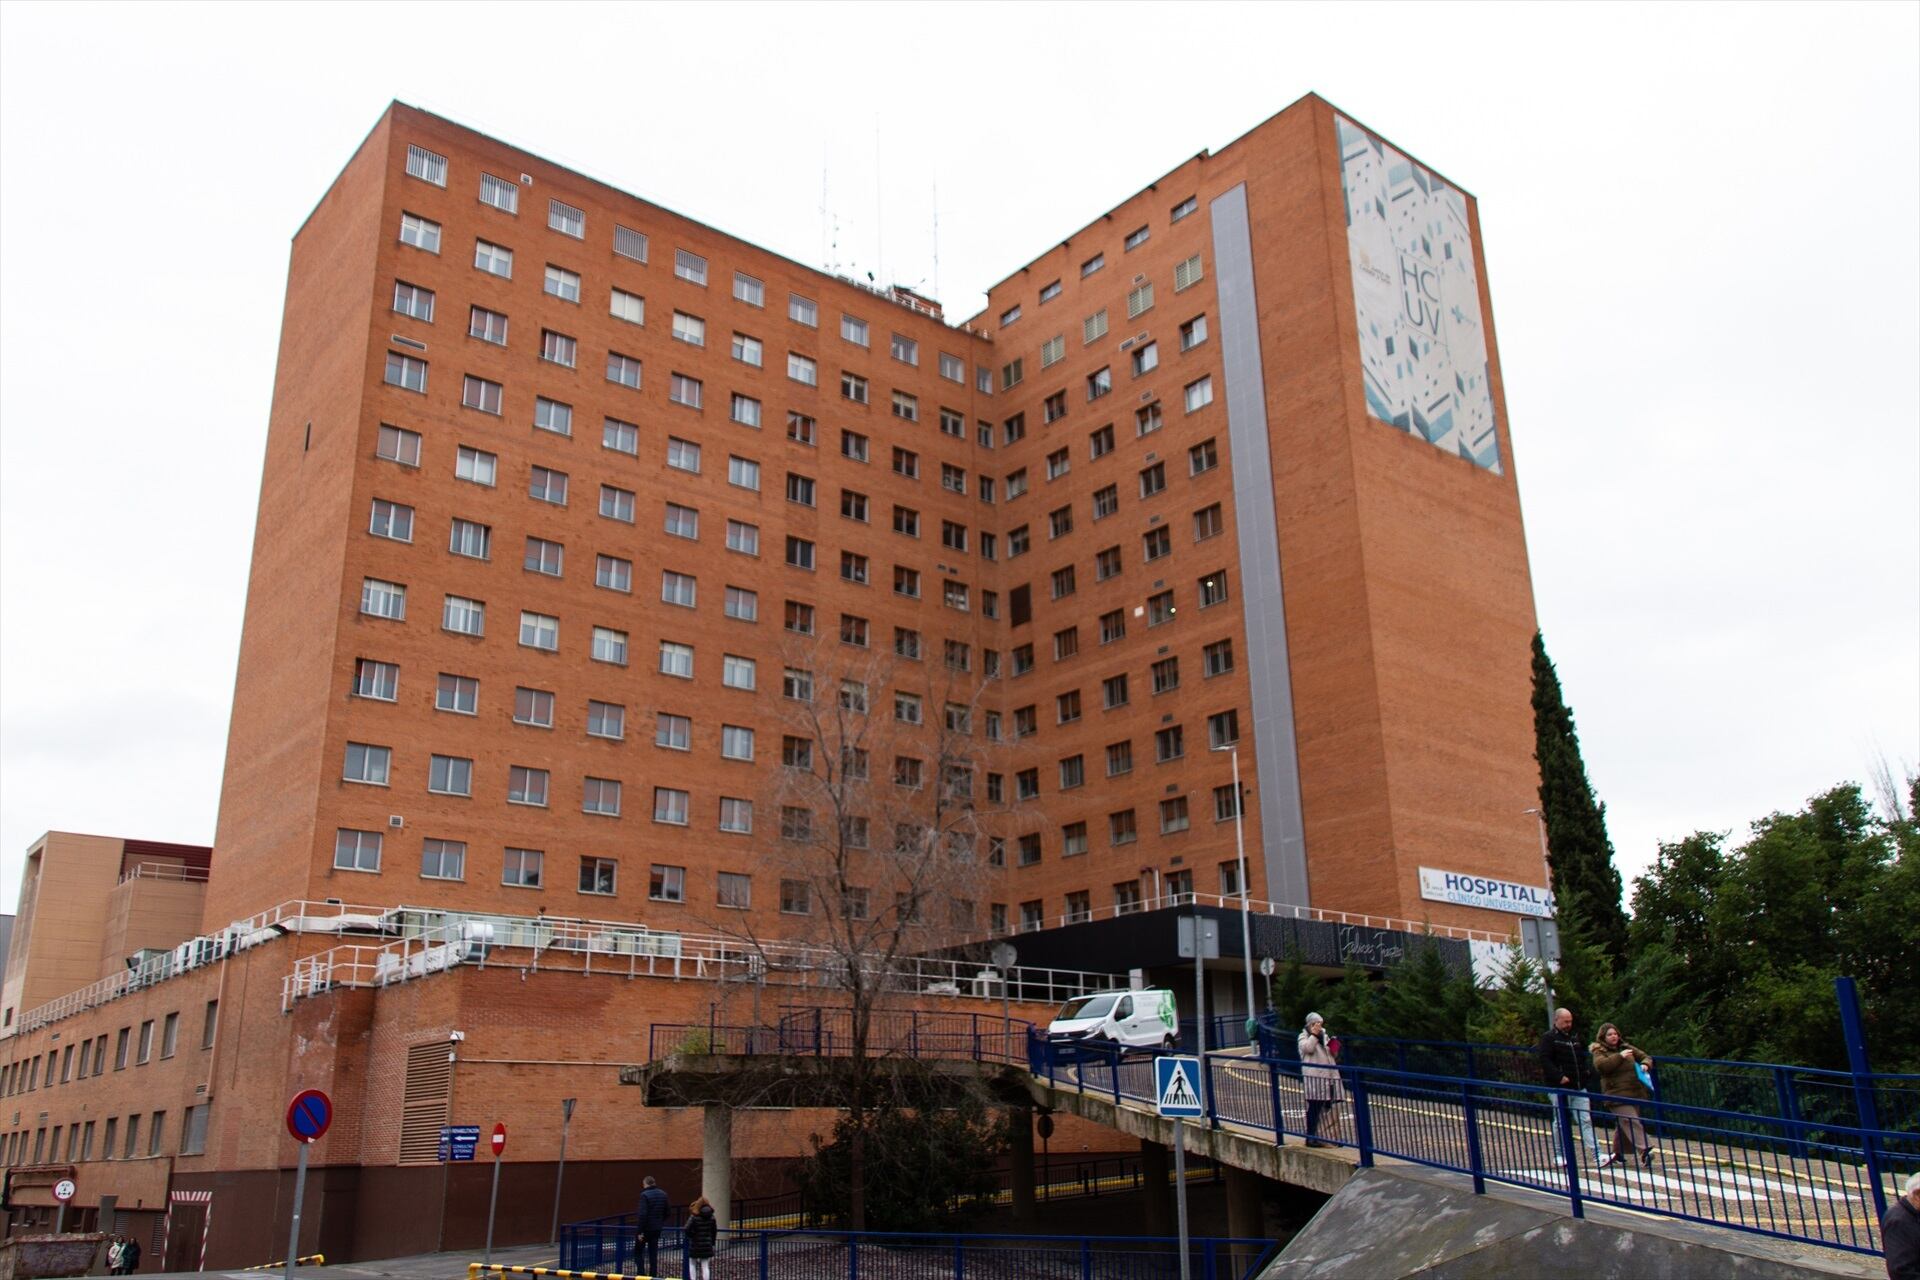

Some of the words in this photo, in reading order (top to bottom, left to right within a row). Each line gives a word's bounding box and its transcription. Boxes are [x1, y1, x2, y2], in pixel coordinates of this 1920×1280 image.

[1400, 255, 1439, 303] HC
[1404, 290, 1440, 336] UV
[1445, 873, 1541, 904] HOSPITAL
[1482, 897, 1544, 915] UNIVERSITARIO
